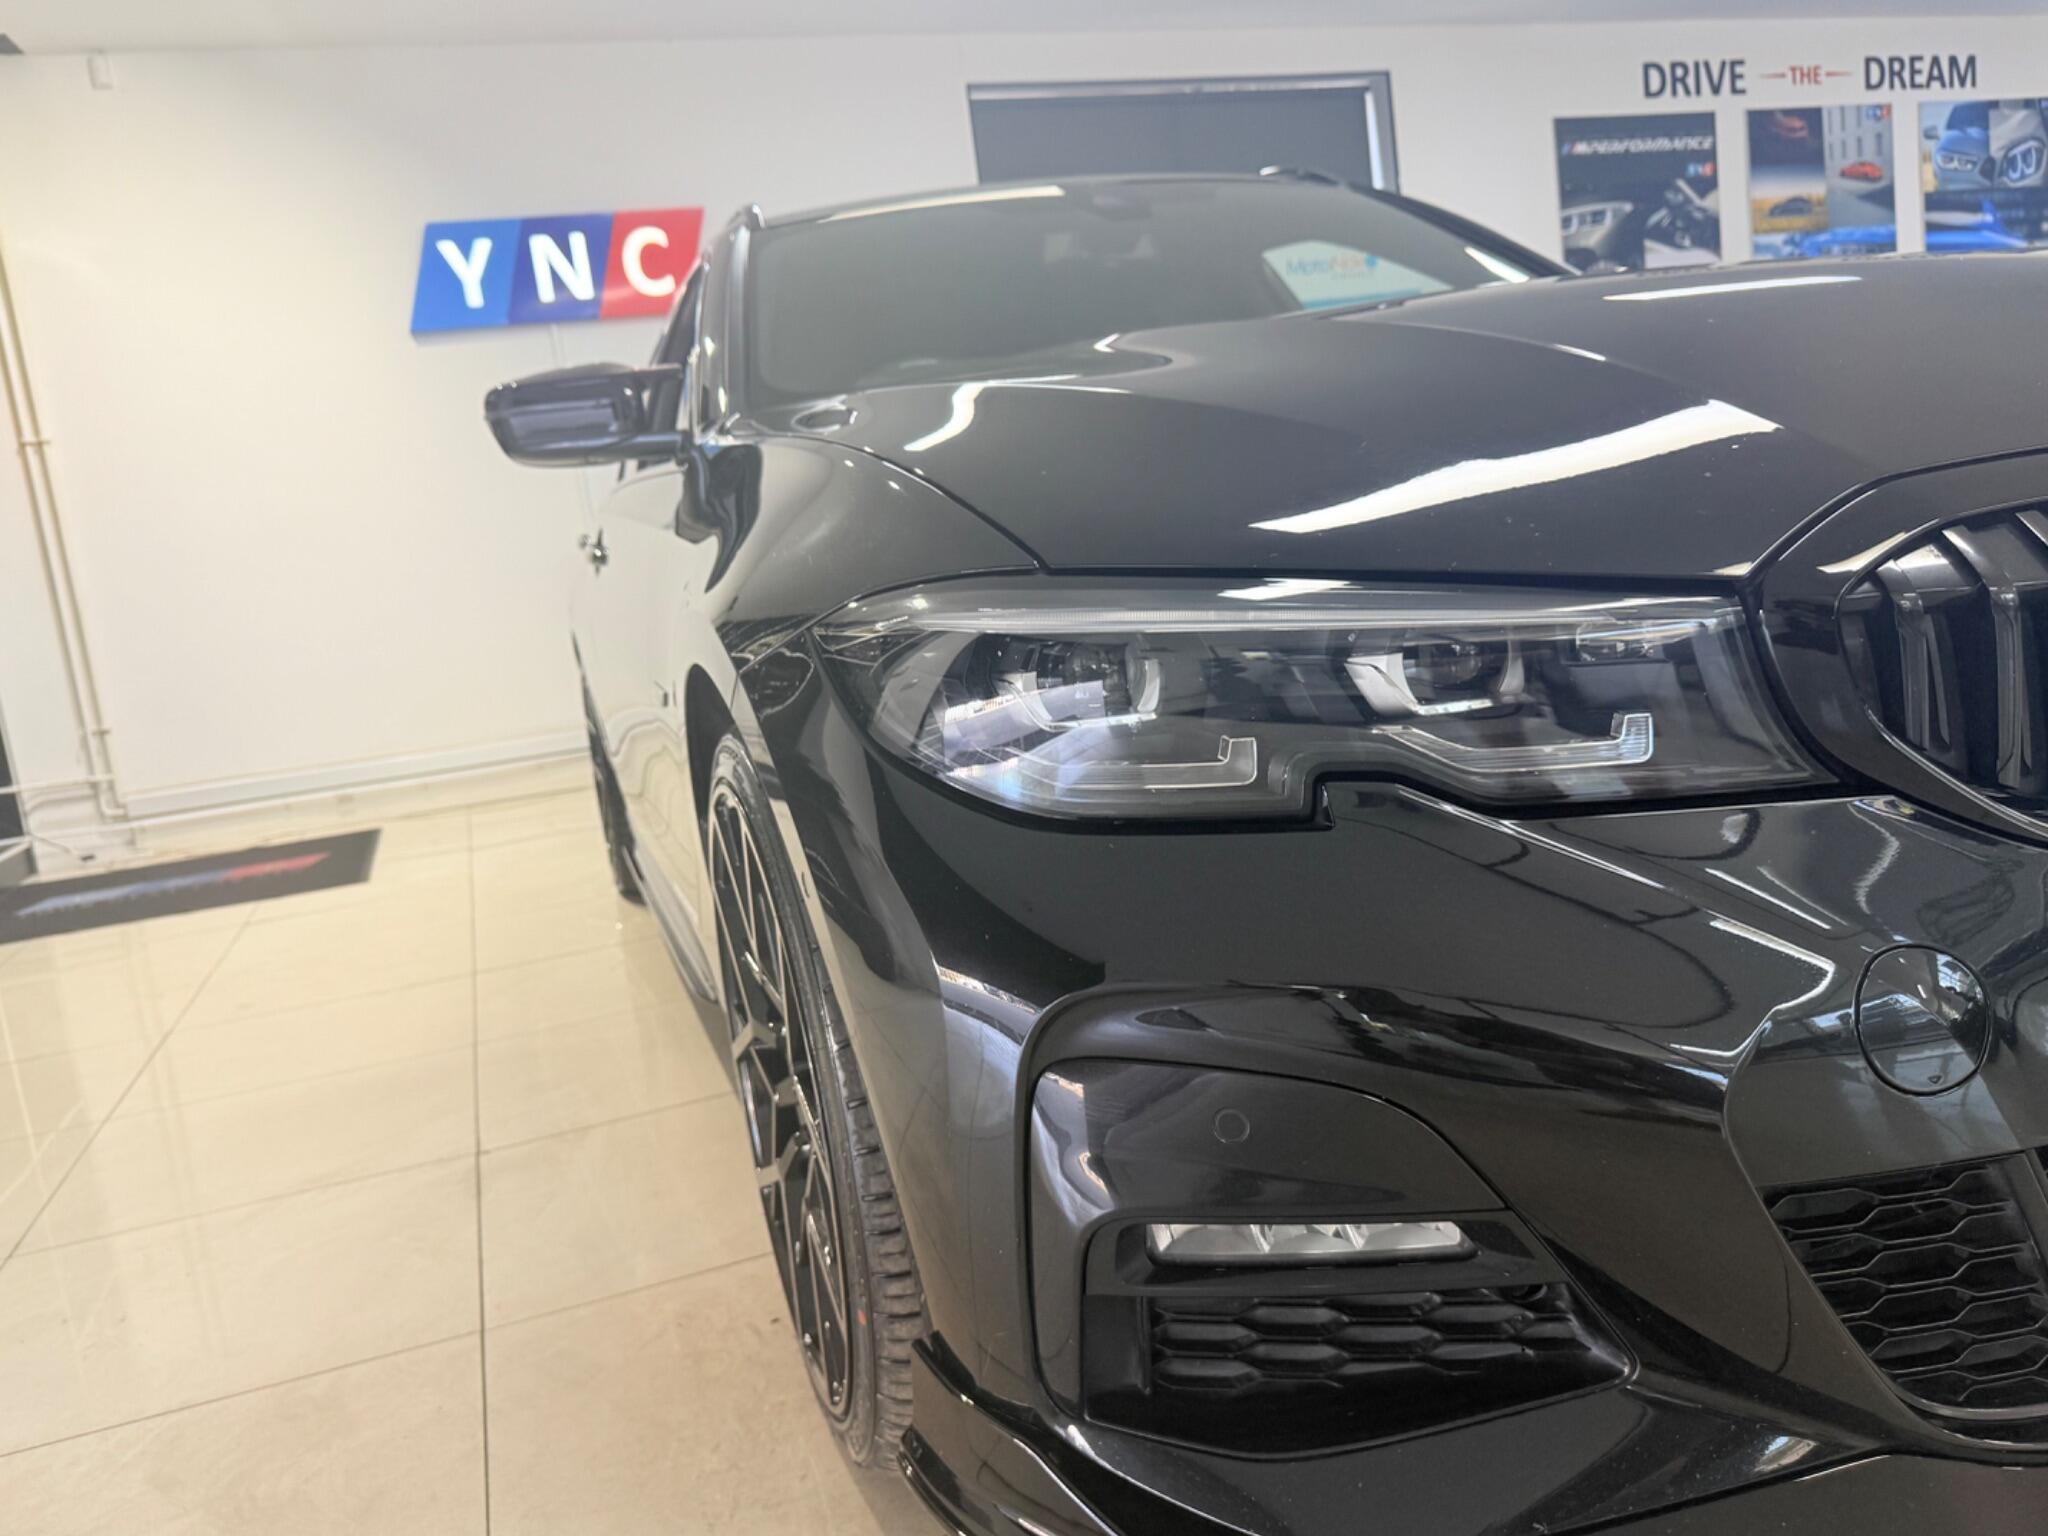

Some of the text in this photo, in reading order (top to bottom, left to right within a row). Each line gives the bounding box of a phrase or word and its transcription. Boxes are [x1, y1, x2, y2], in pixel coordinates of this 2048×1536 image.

[1642, 54, 1977, 98] DRIVE THE DREAM
[436, 226, 676, 309] YNC
